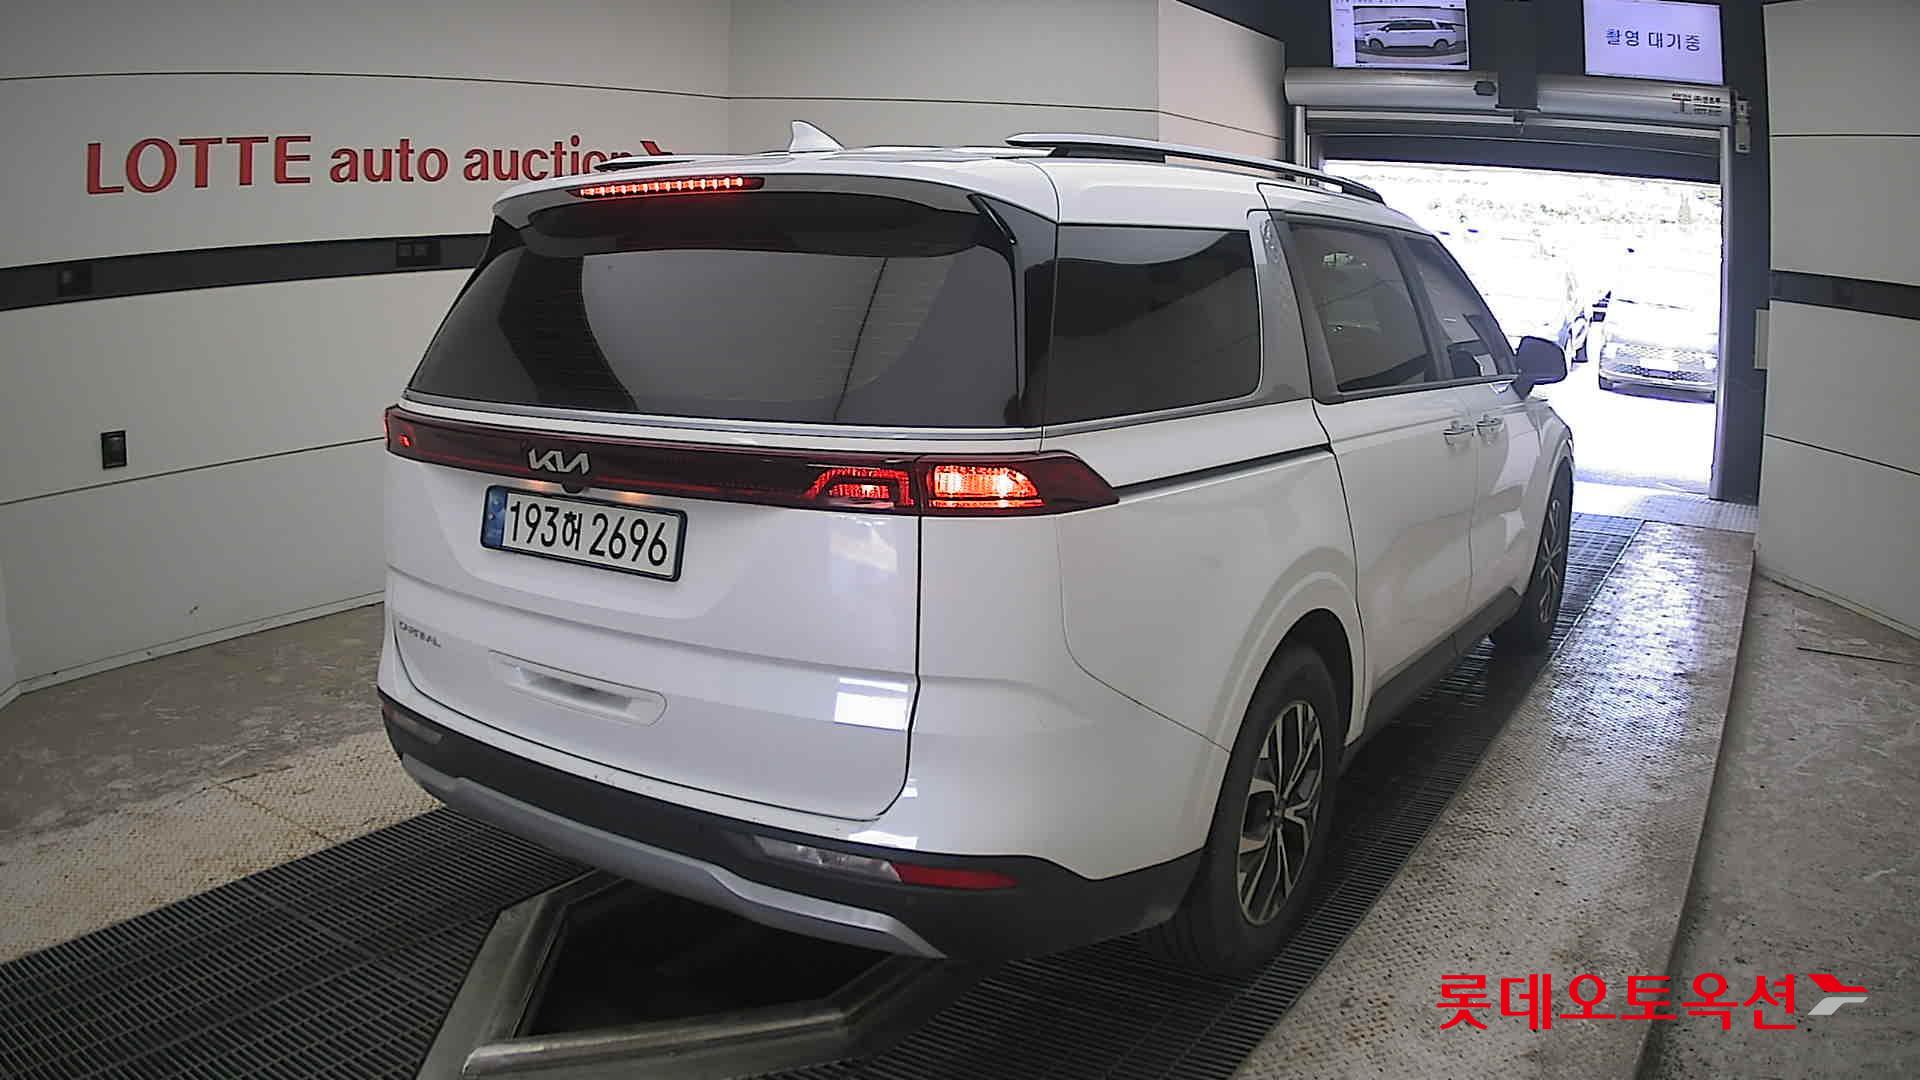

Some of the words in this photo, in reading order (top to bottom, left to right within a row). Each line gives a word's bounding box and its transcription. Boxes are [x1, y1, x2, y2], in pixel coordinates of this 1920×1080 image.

[1606, 28, 1640, 47] 촬영
[1648, 31, 1701, 52] 대기중
[86, 135, 311, 194] LOTTE
[330, 138, 448, 183] auto
[464, 135, 632, 182] auctio
[527, 448, 592, 476] KIA
[509, 500, 583, 551] 193허
[589, 512, 669, 567] 2696
